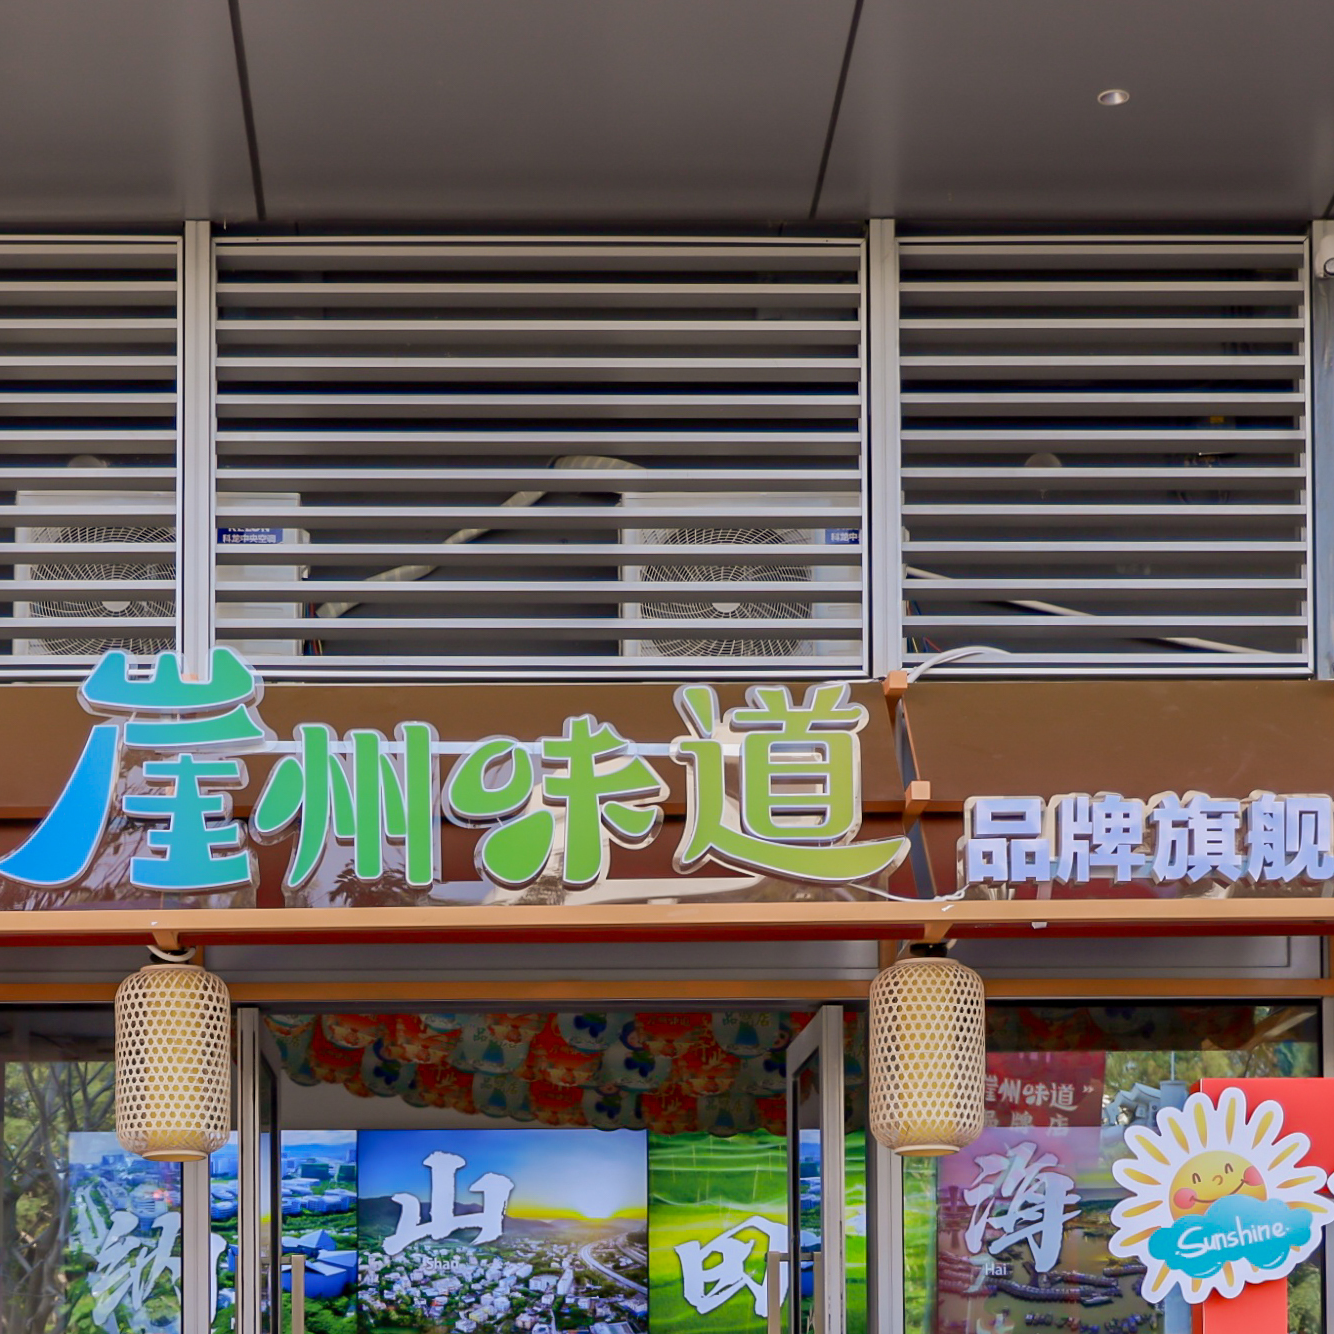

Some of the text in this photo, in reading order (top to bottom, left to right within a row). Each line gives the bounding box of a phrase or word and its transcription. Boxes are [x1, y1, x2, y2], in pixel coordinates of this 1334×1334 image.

[383, 1151, 515, 1256] 山
[1175, 1216, 1287, 1259] Sunshine
[985, 1263, 1008, 1275] Hai
